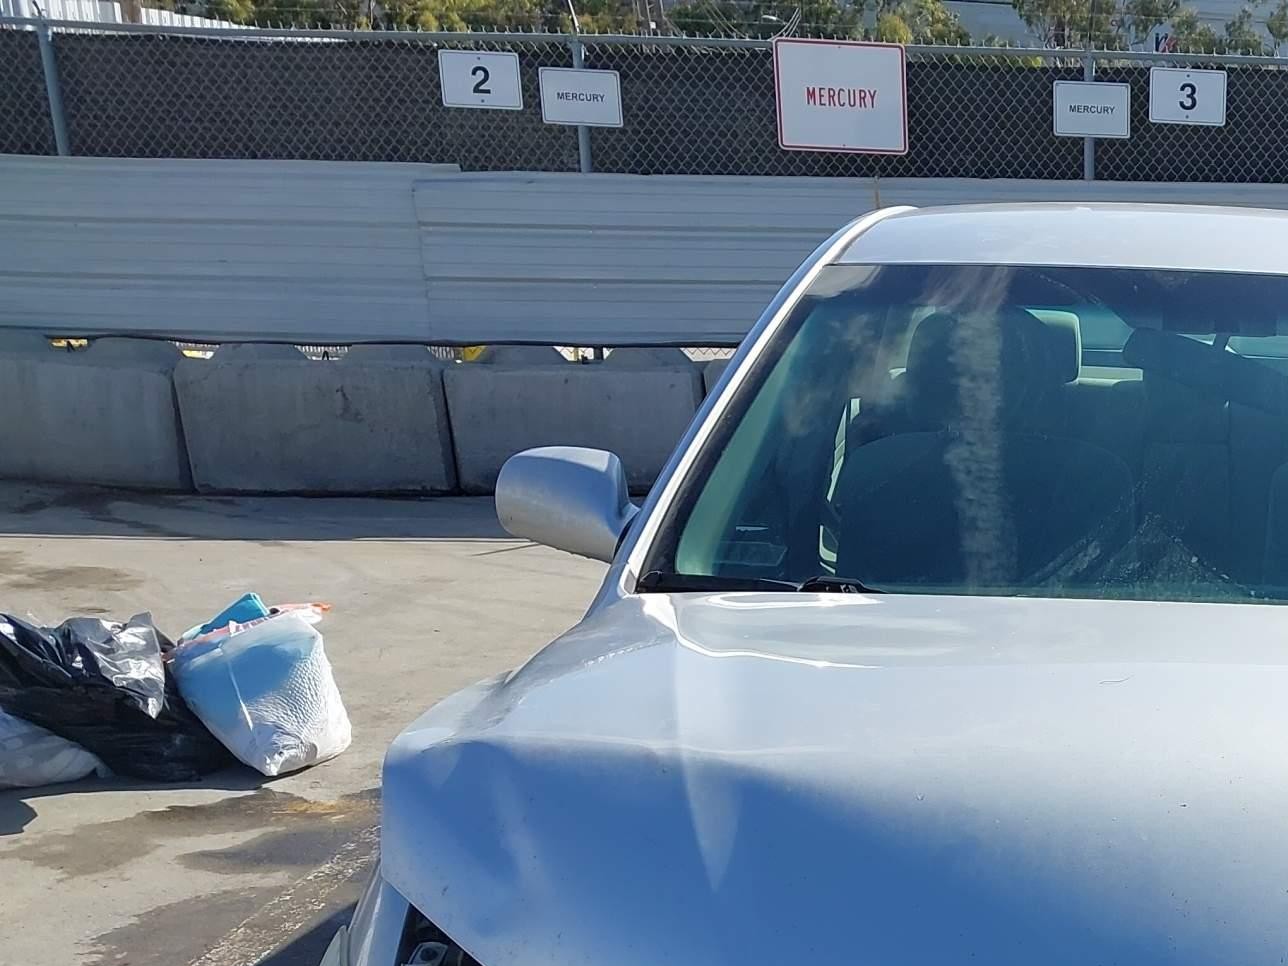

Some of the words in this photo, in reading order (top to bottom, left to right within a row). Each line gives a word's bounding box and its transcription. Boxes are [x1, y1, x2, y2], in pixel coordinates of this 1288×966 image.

[471, 66, 491, 94] 2
[556, 91, 605, 102] MERCURY
[805, 86, 878, 109] MERCURY
[1179, 83, 1197, 111] 3
[1069, 103, 1115, 115] MERCURY
